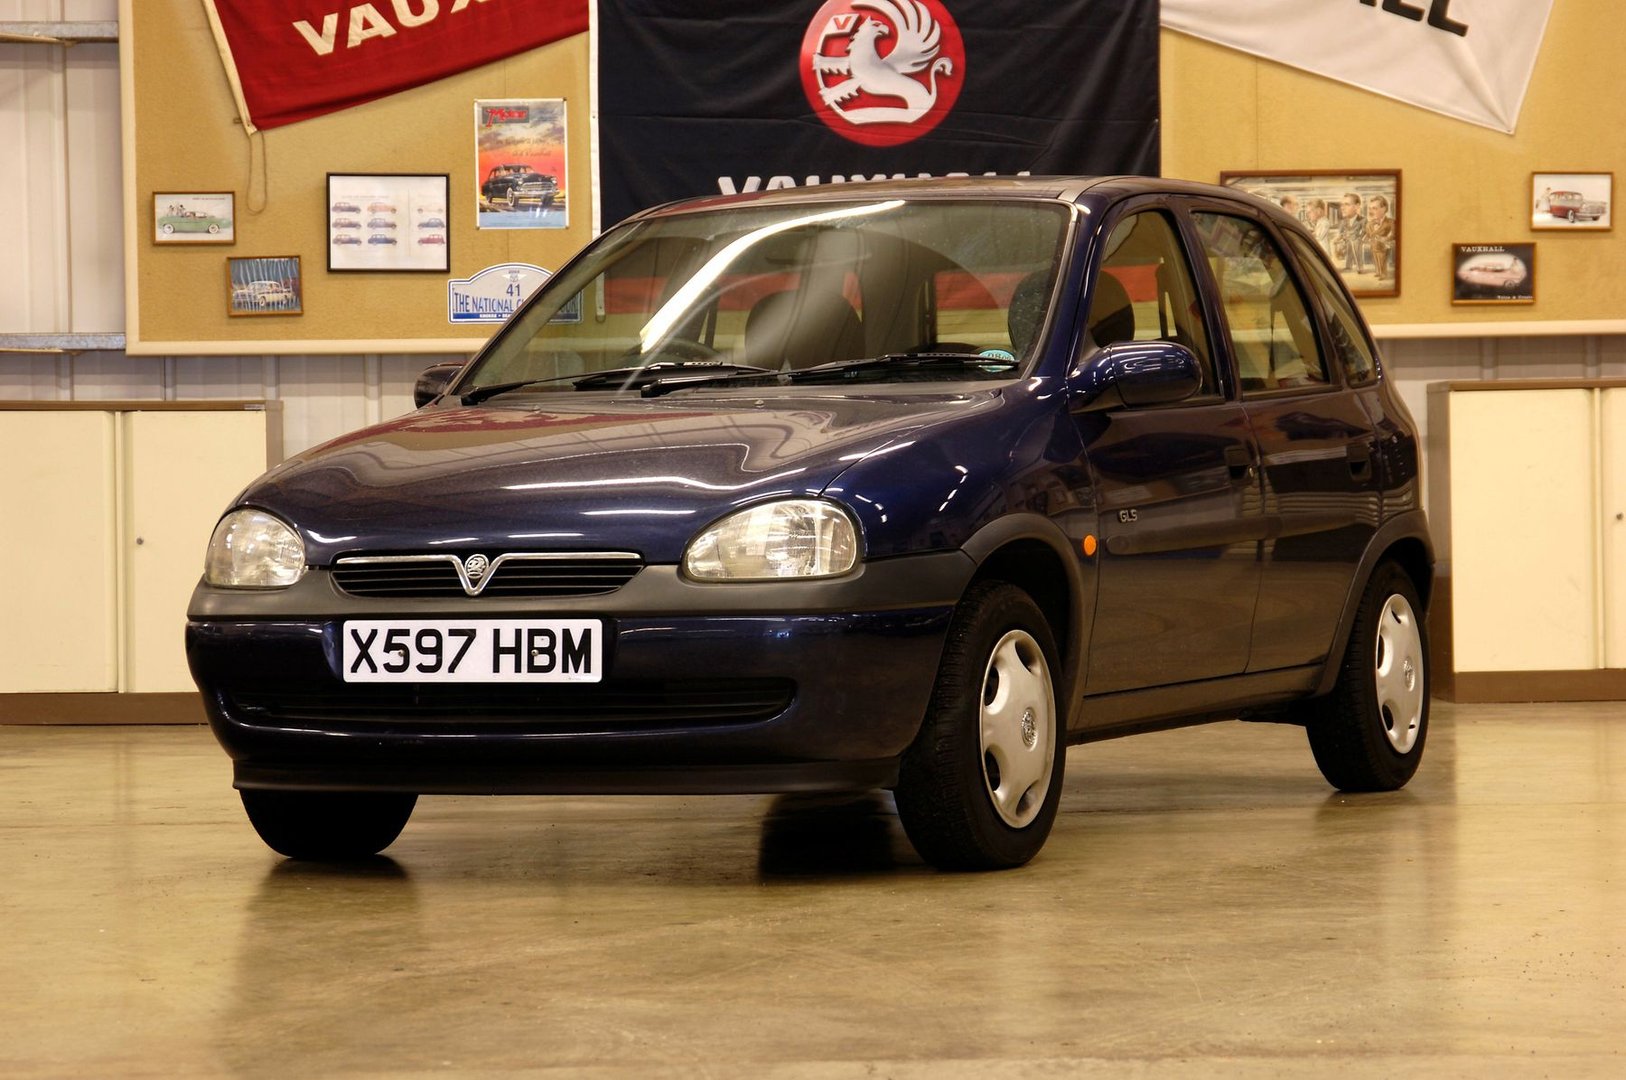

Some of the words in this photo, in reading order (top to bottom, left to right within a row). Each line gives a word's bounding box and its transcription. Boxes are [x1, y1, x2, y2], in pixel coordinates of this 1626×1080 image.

[506, 284, 521, 297] 41
[454, 292, 470, 313] THE
[472, 296, 514, 313] NATIONAL
[1119, 509, 1138, 523] GLS
[350, 628, 477, 673] X597
[492, 628, 592, 673] HBM
